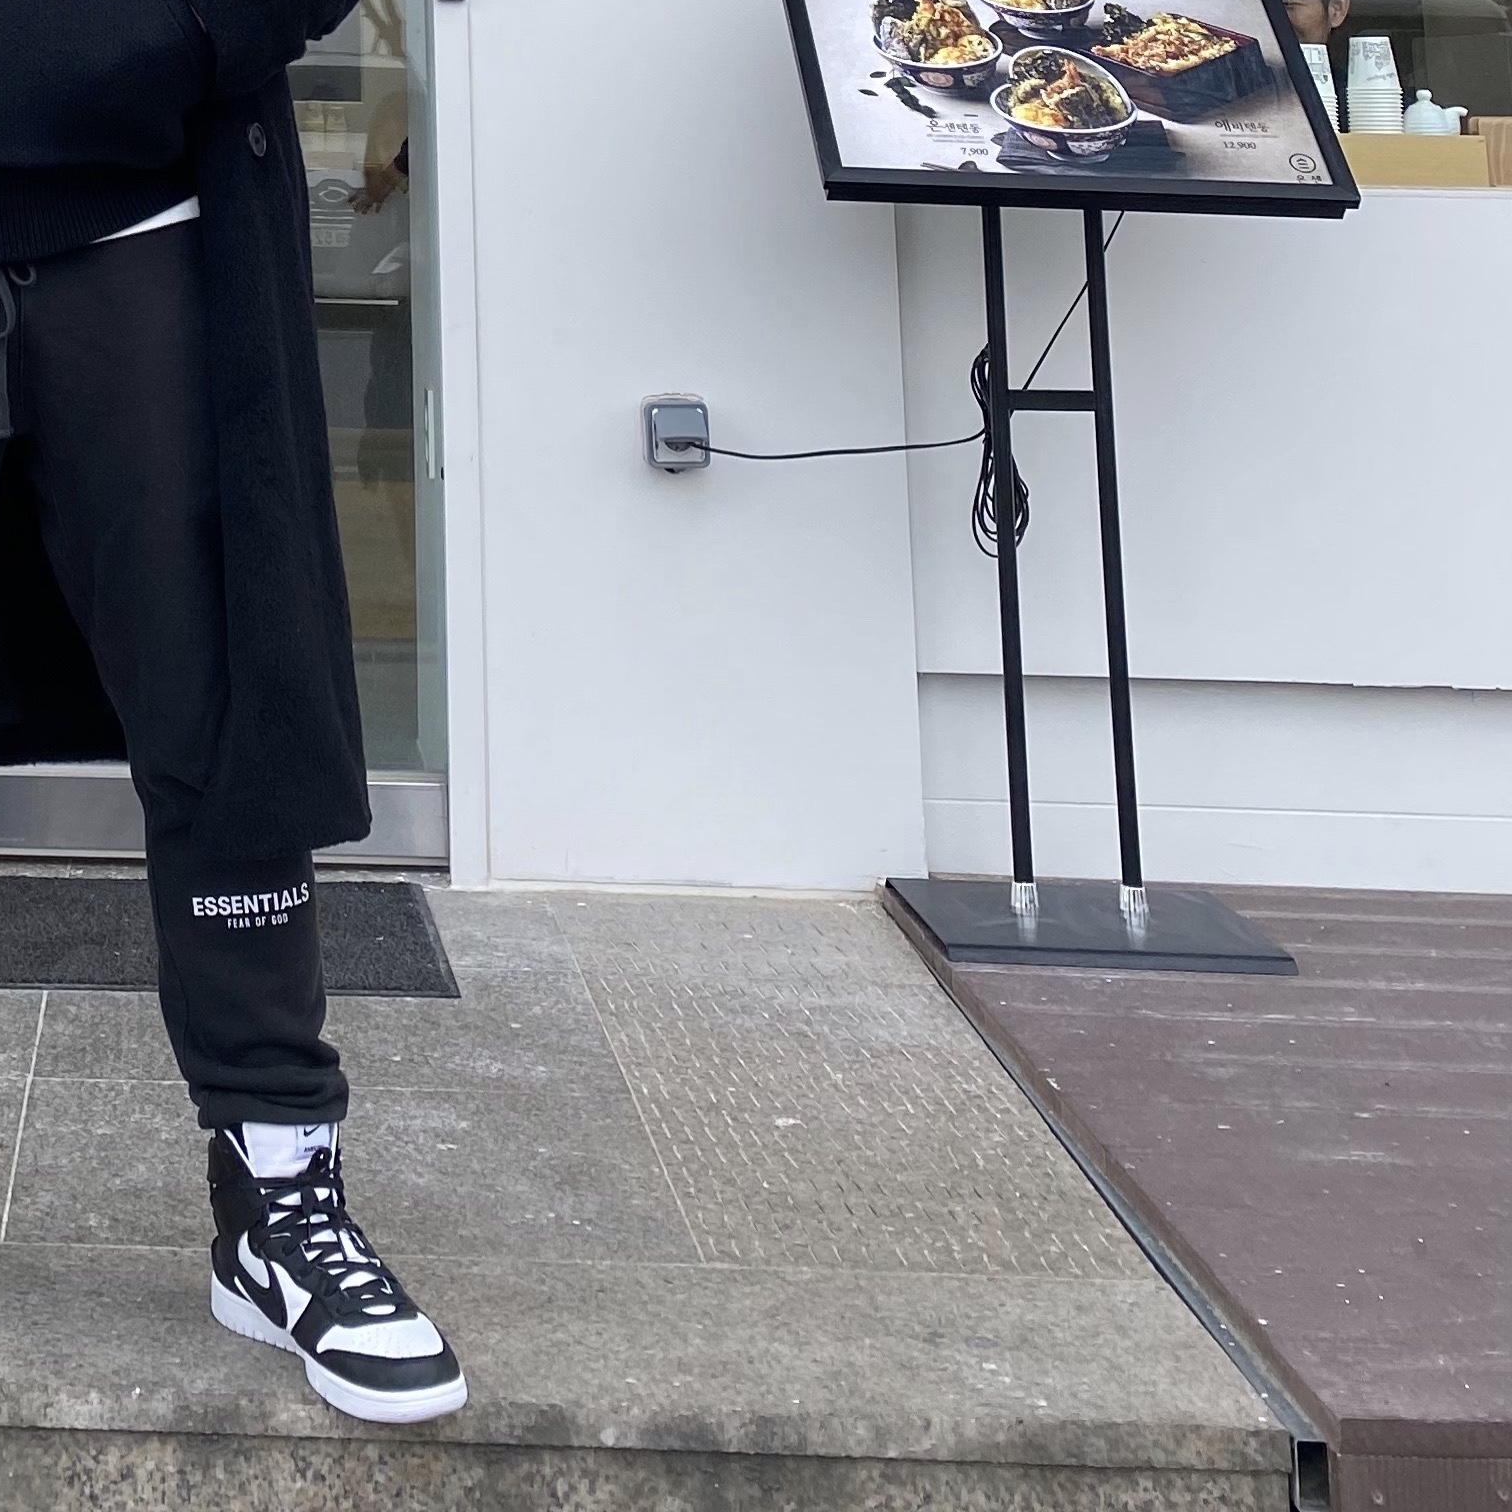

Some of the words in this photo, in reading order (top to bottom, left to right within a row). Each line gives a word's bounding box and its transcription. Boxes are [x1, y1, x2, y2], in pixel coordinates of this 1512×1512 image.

[1214, 117, 1271, 134] 에비텐동
[960, 147, 989, 157] 7,900
[1223, 140, 1257, 151] 12,900
[191, 881, 311, 917] ESSENTIALS
[227, 917, 252, 930] FEAR
[255, 915, 268, 928] OF
[271, 912, 290, 926] GOD
